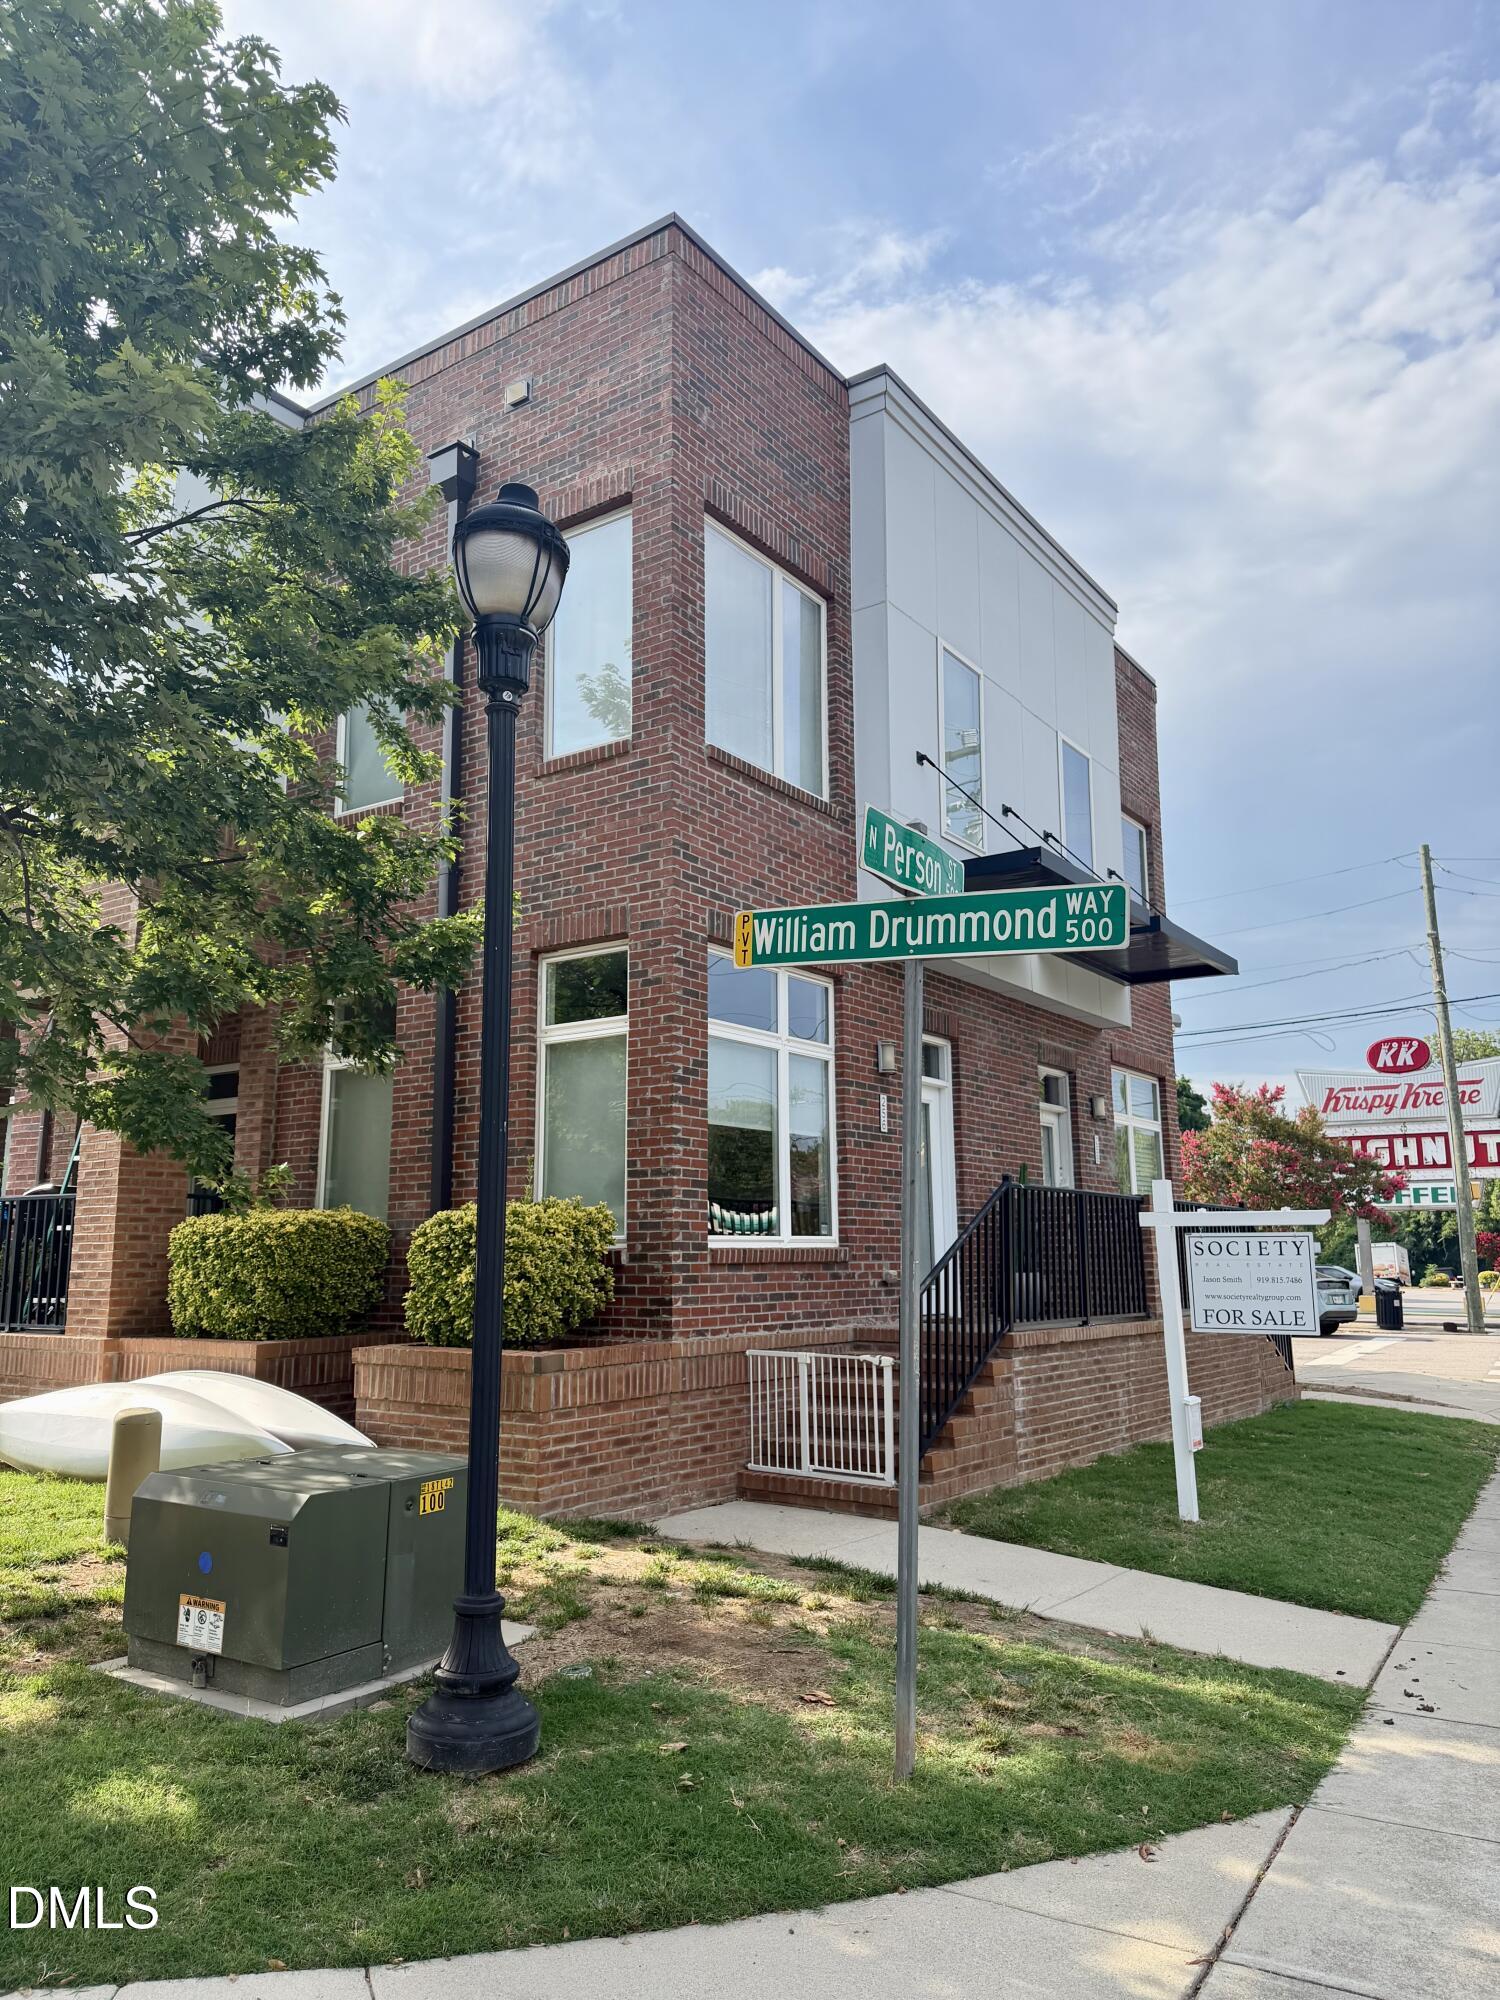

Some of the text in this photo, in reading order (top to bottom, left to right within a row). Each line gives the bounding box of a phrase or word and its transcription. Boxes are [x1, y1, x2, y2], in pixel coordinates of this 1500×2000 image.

[869, 824, 877, 850] N
[884, 823, 942, 895] Person
[948, 859, 957, 883] ST
[753, 889, 1114, 956] William Drummond WAY
[1065, 917, 1113, 943] 500
[742, 914, 750, 964] PVT
[1376, 1040, 1419, 1068] KK
[1321, 1084, 1401, 1115] Krispy
[1194, 1240, 1304, 1257] SOCIETY
[1202, 1275, 1303, 1284] Jason Smith 919.815.7486
[1204, 1293, 1302, 1302] www.societyrealtygroup.com
[1202, 1308, 1307, 1326] FOR SALE
[421, 1491, 444, 1513] 100
[192, 1598, 220, 1611] WARNING
